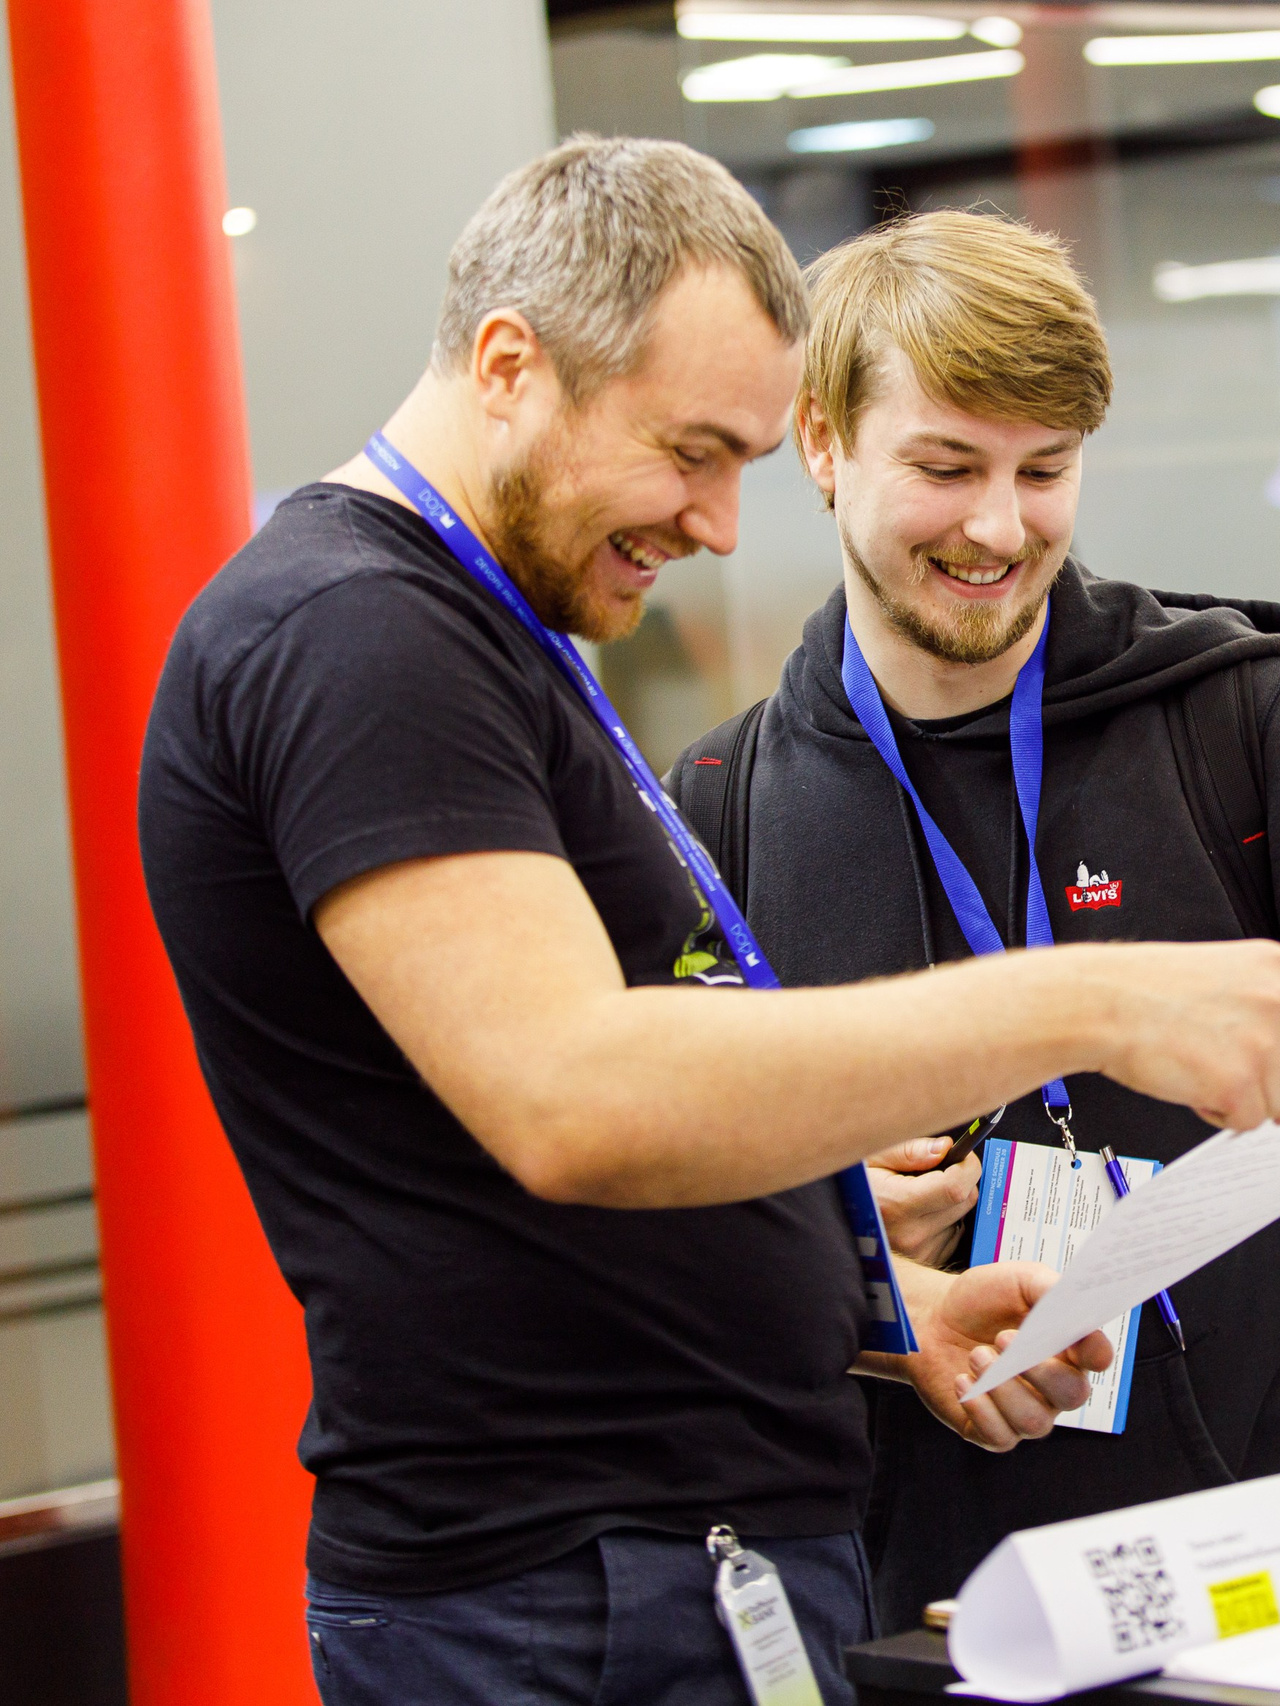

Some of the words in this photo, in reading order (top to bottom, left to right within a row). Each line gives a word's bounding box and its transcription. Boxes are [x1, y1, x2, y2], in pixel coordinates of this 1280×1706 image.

[986, 1178, 996, 1215] CONFERENCE
[993, 1147, 1001, 1177] SCHEDULE
[997, 1157, 1005, 1188] NOVEMBER
[1002, 1148, 1007, 1156] 20
